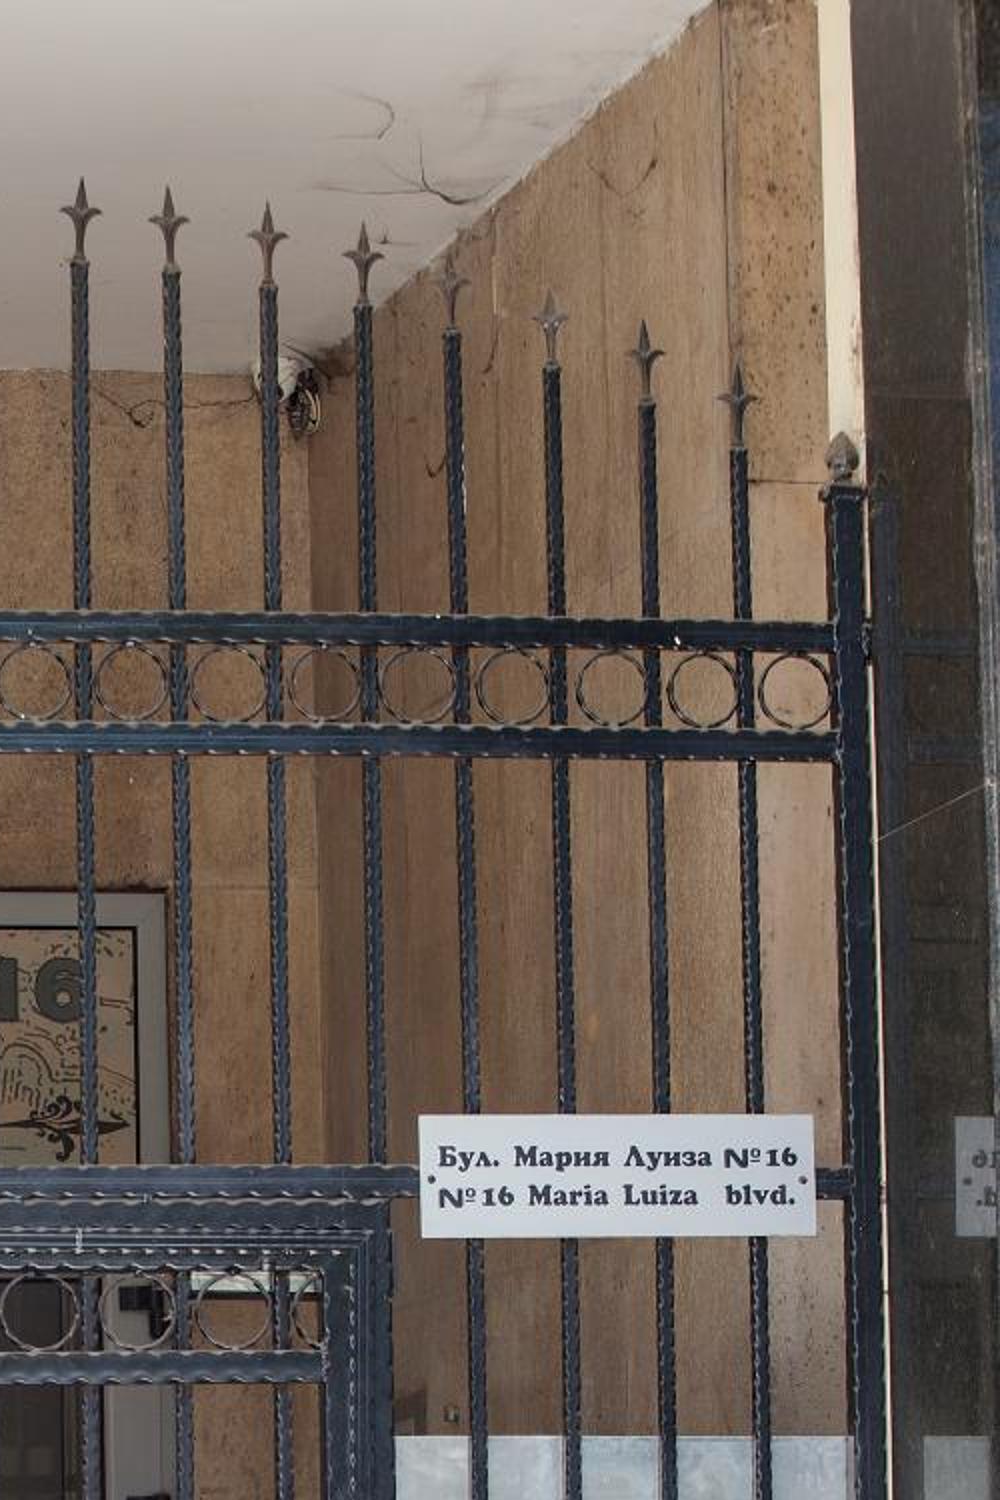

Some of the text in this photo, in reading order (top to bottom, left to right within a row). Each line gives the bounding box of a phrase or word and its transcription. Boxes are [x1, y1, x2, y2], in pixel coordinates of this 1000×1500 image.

[438, 1146, 500, 1172] Бул.
[514, 1146, 610, 1171] Мария
[624, 1146, 712, 1168] Луиза
[528, 1184, 609, 1206] Maria
[623, 1184, 699, 1206] Luiza
[725, 1183, 796, 1206] blvd.
